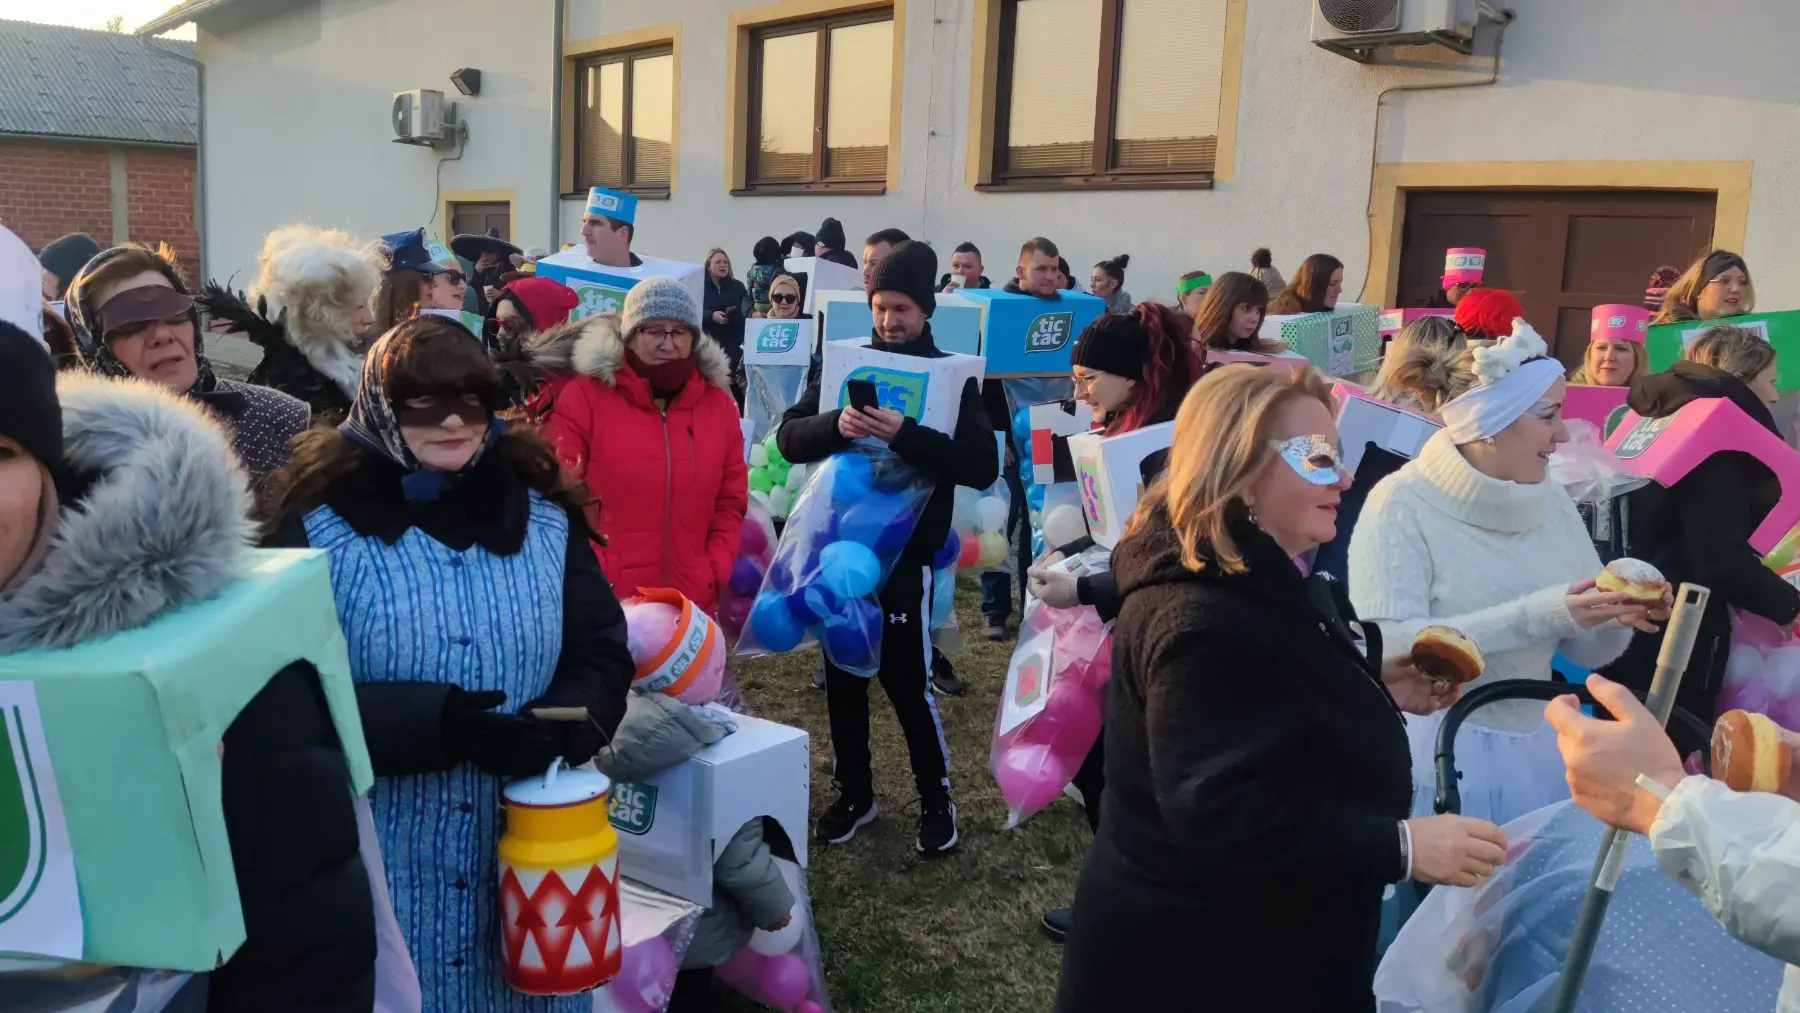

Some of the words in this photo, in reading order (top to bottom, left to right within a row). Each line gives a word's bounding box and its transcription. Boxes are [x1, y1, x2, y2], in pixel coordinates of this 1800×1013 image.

[769, 325, 791, 338] tic
[1039, 316, 1063, 333] tic
[762, 336, 789, 348] tac
[1032, 331, 1061, 346] tac
[864, 374, 909, 408] ic
[1622, 430, 1655, 451] tac
[616, 783, 649, 809] tic
[609, 798, 644, 826] tac
